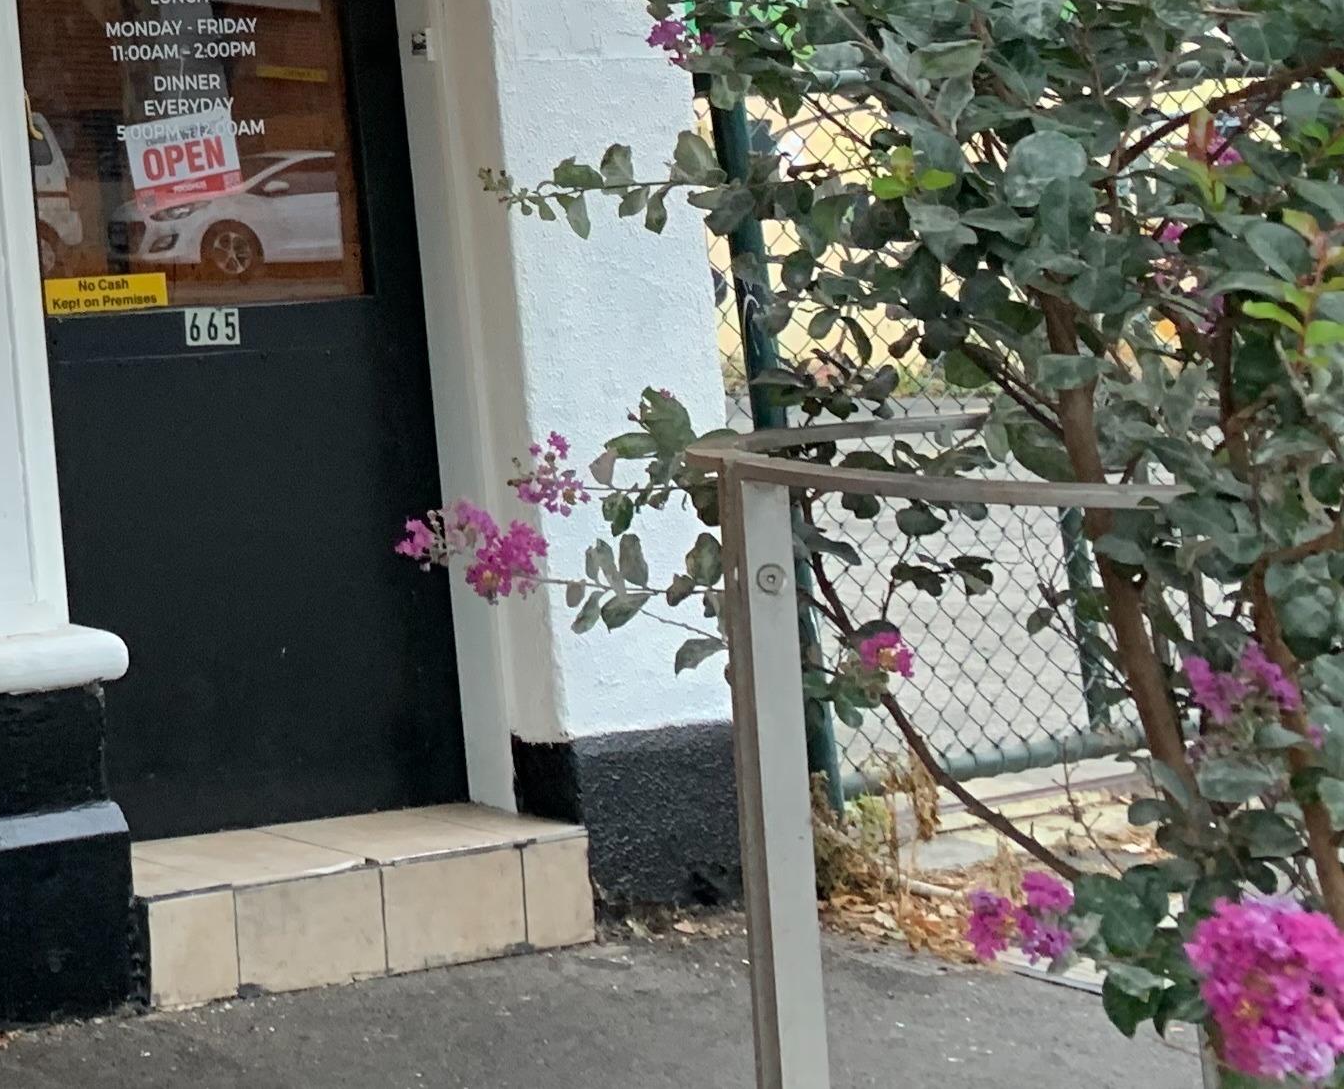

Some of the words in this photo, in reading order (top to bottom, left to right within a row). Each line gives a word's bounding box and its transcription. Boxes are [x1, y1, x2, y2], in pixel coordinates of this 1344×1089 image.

[106, 20, 182, 38] MONDAY
[197, 18, 257, 35] FRIDAY
[111, 44, 179, 61] 11:00AM
[194, 42, 256, 59] 2:00PM
[154, 74, 220, 91] DINNER
[144, 97, 234, 116] EVERYDAY
[143, 135, 226, 181] OPEN
[78, 280, 96, 292] No
[98, 278, 129, 292] Cash
[52, 297, 81, 311] Kept
[84, 298, 100, 307] on
[103, 294, 158, 306] Premises
[189, 312, 237, 342] 665
